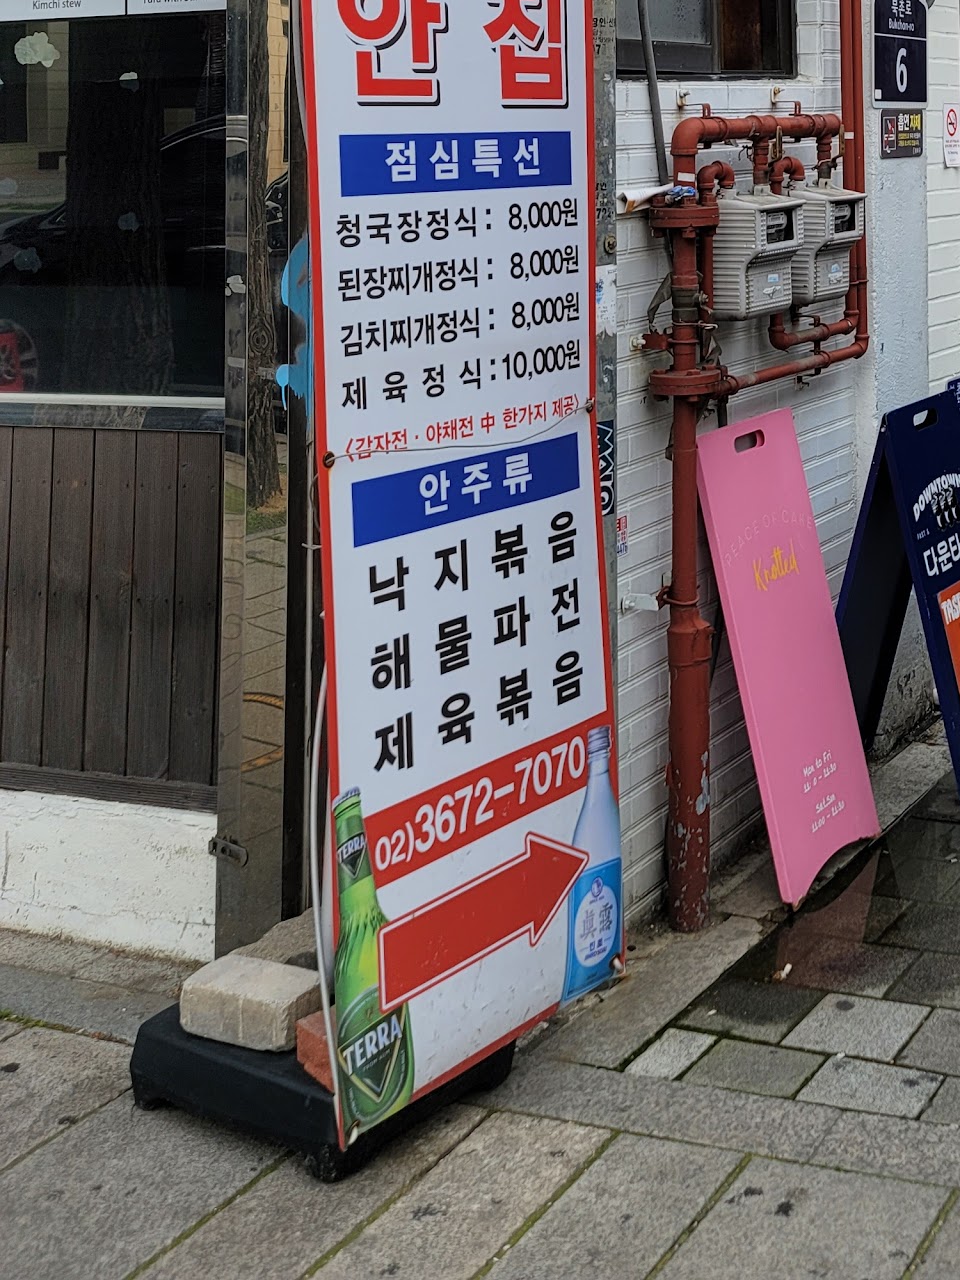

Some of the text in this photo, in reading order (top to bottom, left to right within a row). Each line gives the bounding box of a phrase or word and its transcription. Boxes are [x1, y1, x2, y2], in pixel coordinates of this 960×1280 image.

[32, 0, 60, 10] Kimchi
[895, 47, 908, 93] 6
[385, 137, 541, 183] 점심특선
[508, 197, 578, 233] 8,000원
[510, 245, 580, 282] 8,000원
[511, 292, 581, 331] 8,000원
[502, 339, 581, 380] 10,000원
[502, 406, 547, 429] 한가지
[419, 452, 533, 515] 안주류
[369, 510, 578, 611] 낙지볶음
[753, 538, 800, 591] Knotted
[370, 577, 581, 690] 해물파전
[374, 650, 584, 772] 제육볶음
[375, 735, 587, 871] 02)3672-7070
[337, 832, 366, 863] TERRA
[343, 1013, 402, 1075] TERRA
